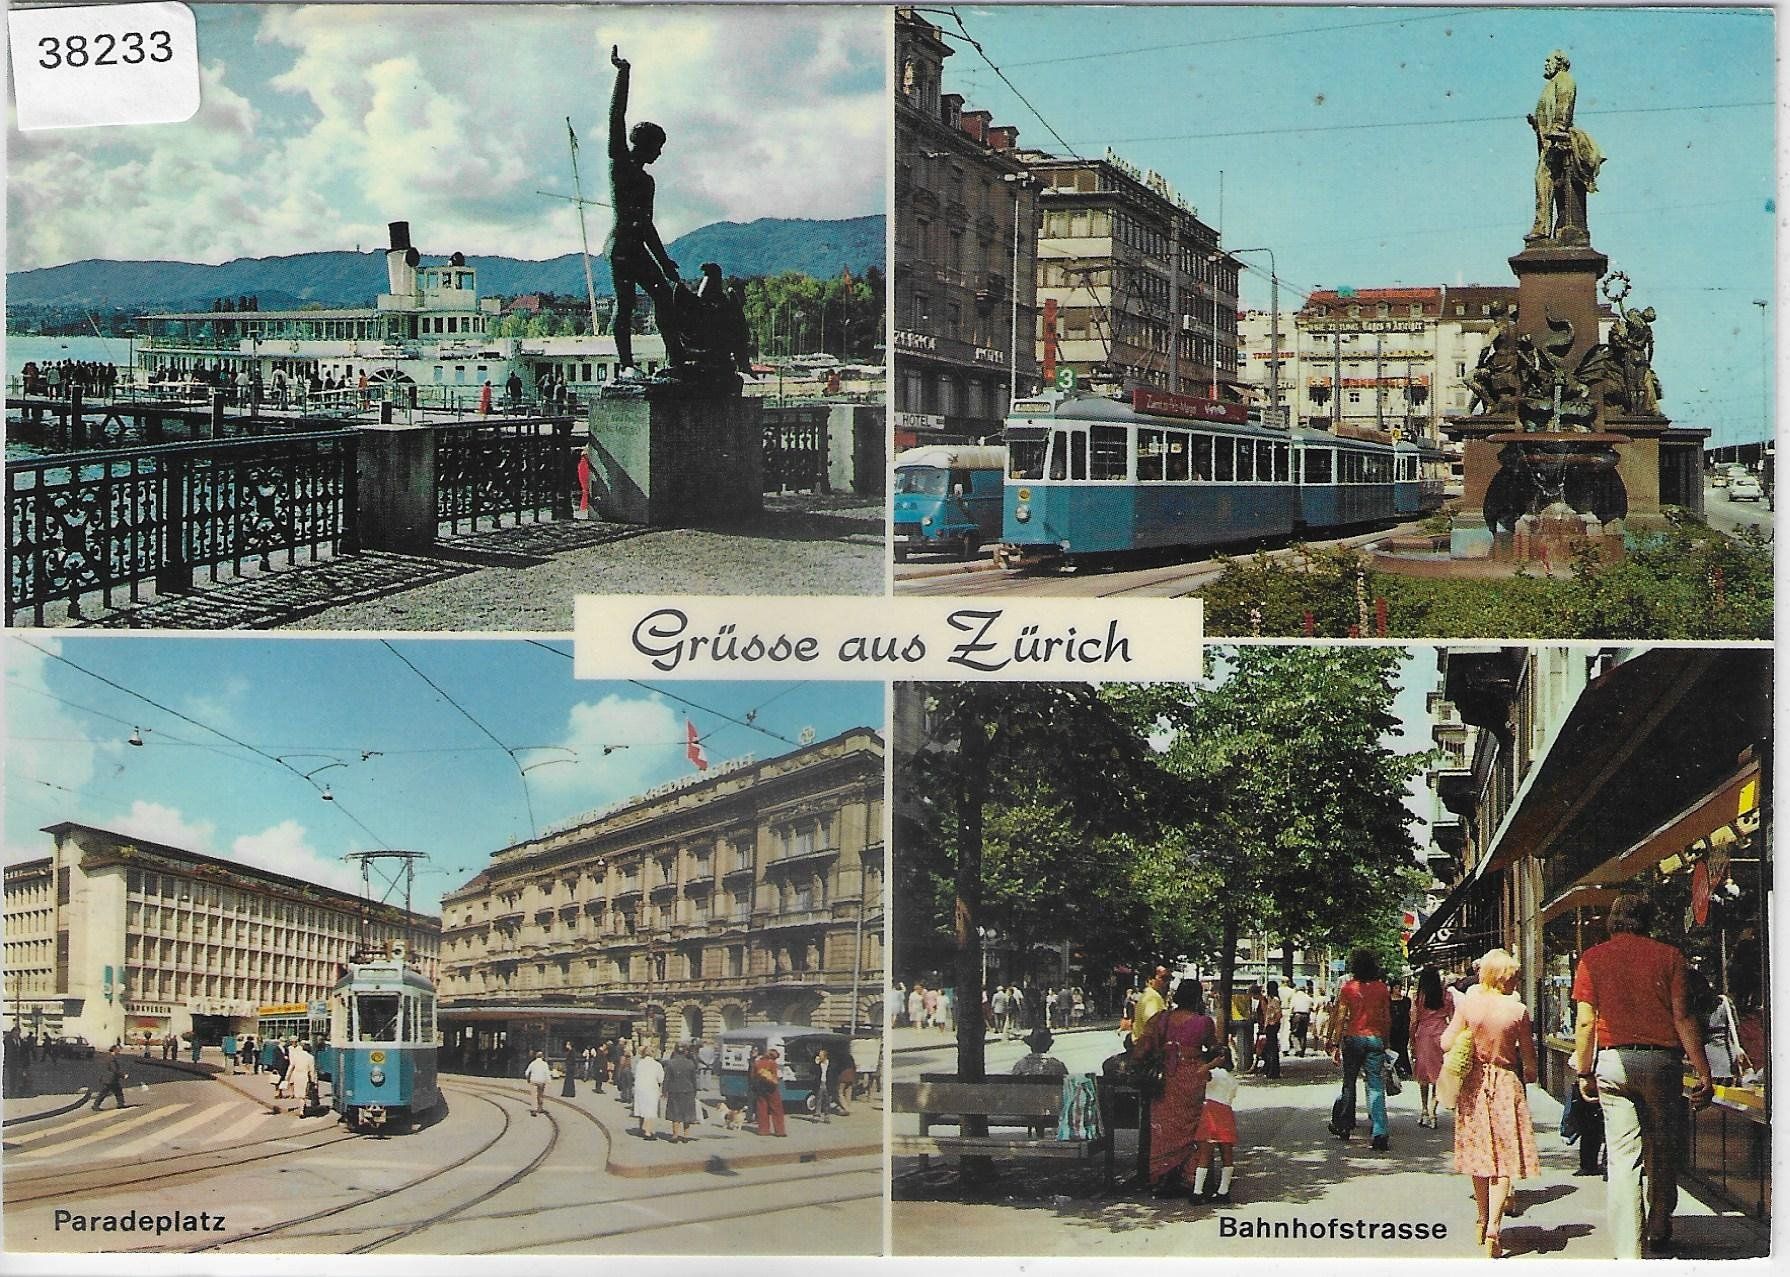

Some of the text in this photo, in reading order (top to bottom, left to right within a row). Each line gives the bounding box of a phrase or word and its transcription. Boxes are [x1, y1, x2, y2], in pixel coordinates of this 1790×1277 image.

[38, 30, 173, 69] 38233
[1059, 369, 1073, 389] 3
[902, 414, 931, 427] HOTEL
